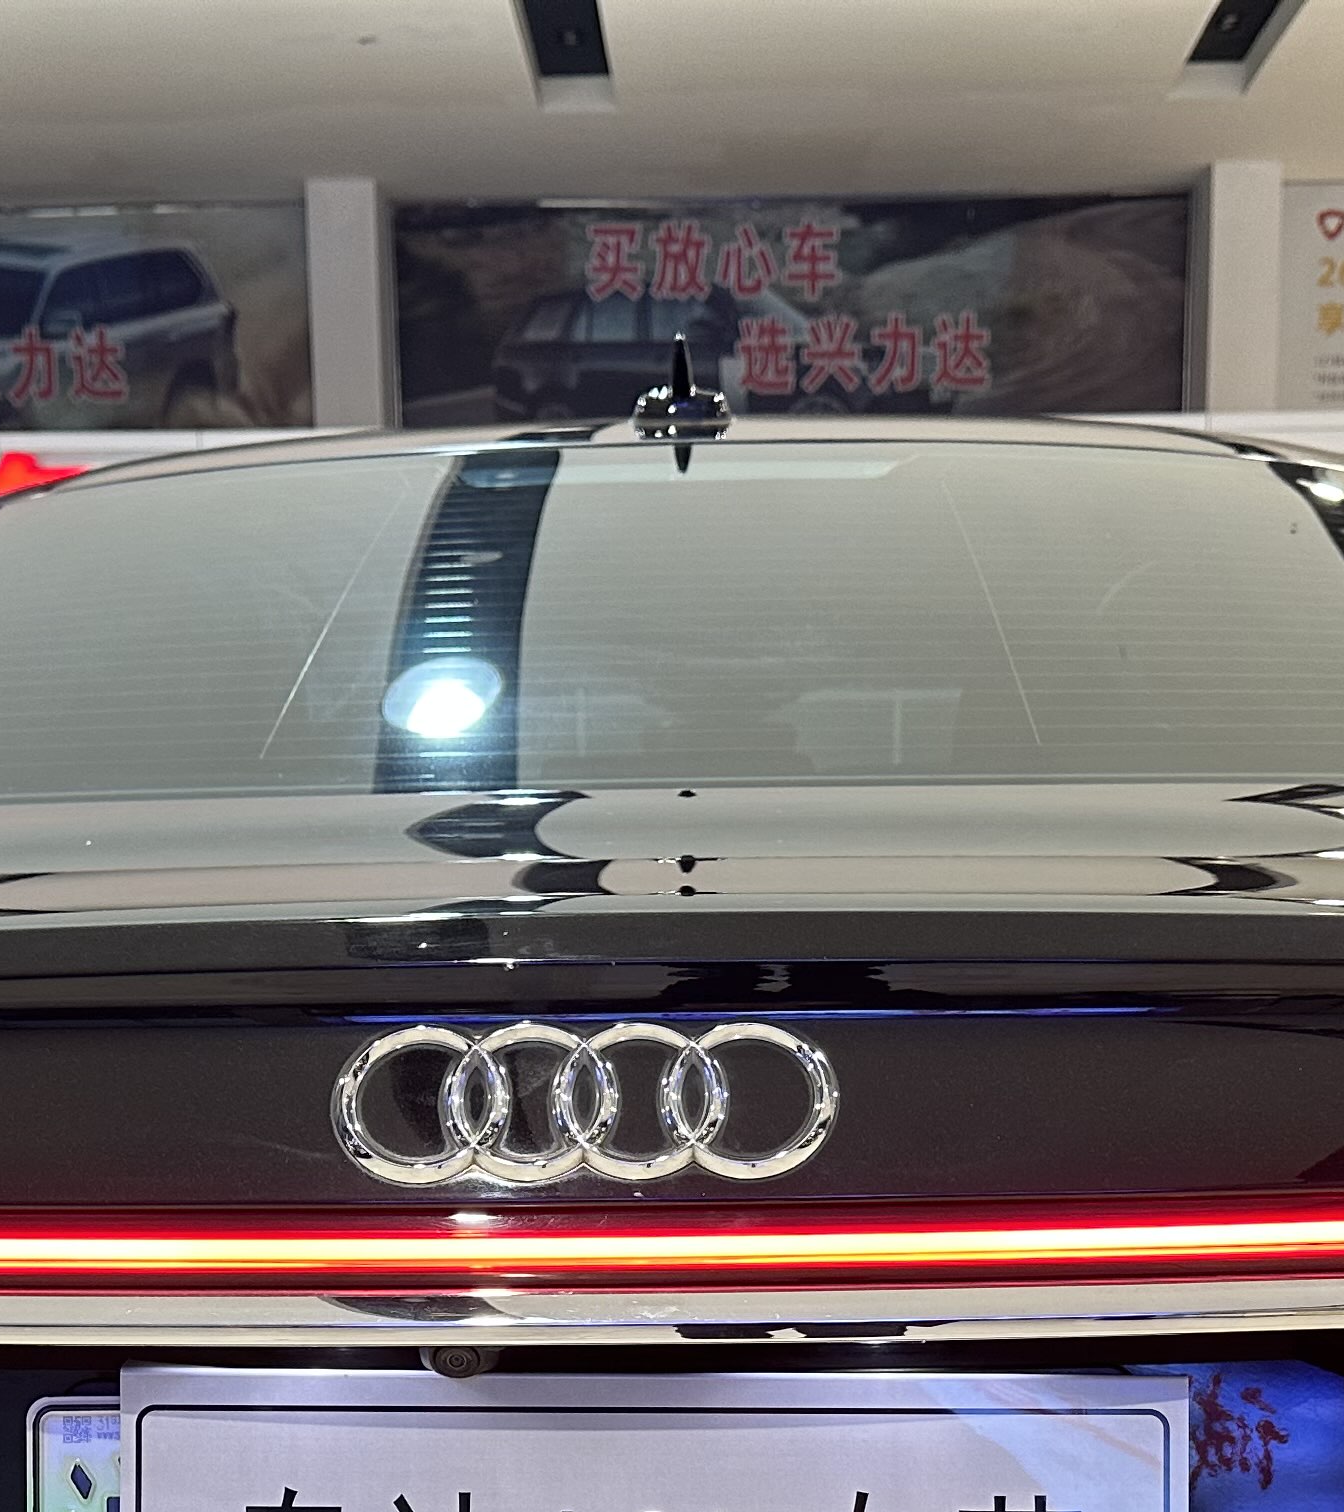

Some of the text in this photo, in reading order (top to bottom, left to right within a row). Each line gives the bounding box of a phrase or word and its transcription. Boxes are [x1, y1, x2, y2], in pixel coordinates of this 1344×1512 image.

[586, 219, 843, 302] 买放心车
[738, 312, 993, 394] 选兴力达
